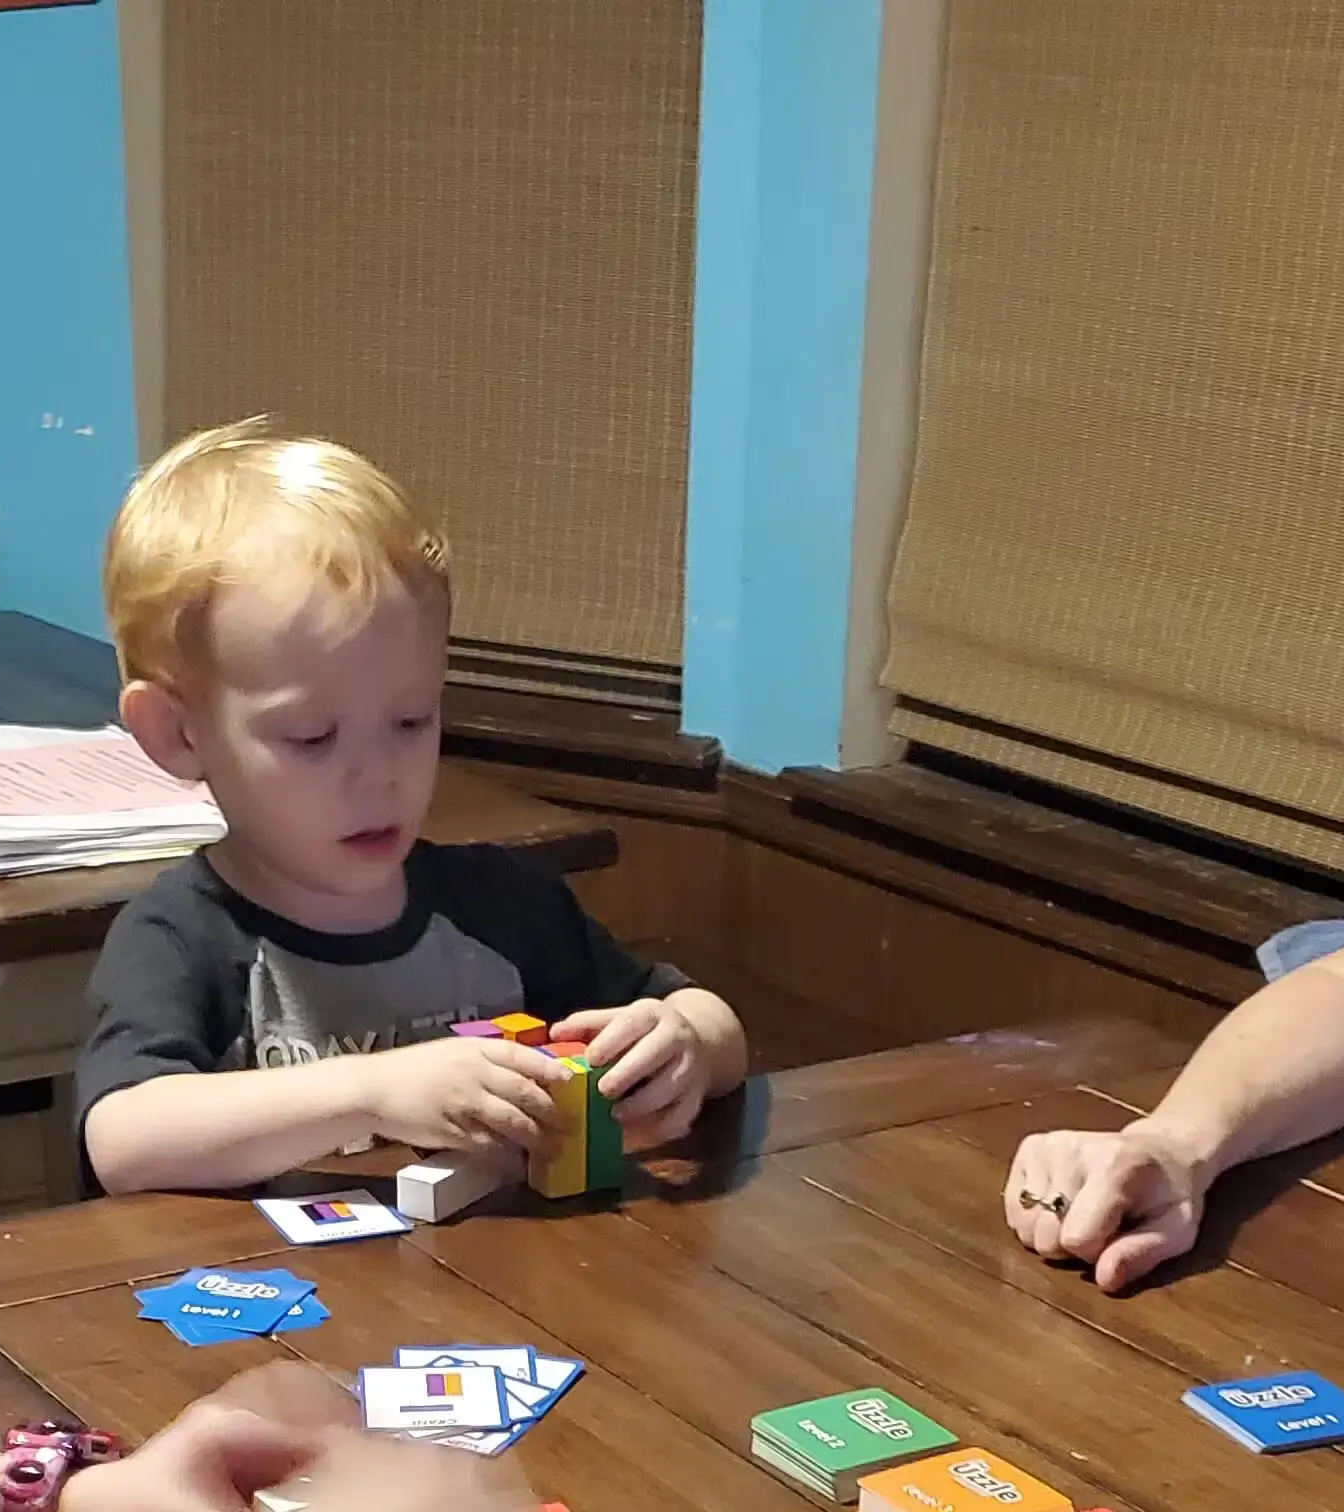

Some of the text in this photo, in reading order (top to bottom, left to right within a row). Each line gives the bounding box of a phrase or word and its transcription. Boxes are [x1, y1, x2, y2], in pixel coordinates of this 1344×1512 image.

[797, 1420, 846, 1449] Level 2
[1277, 1416, 1326, 1431] Level
